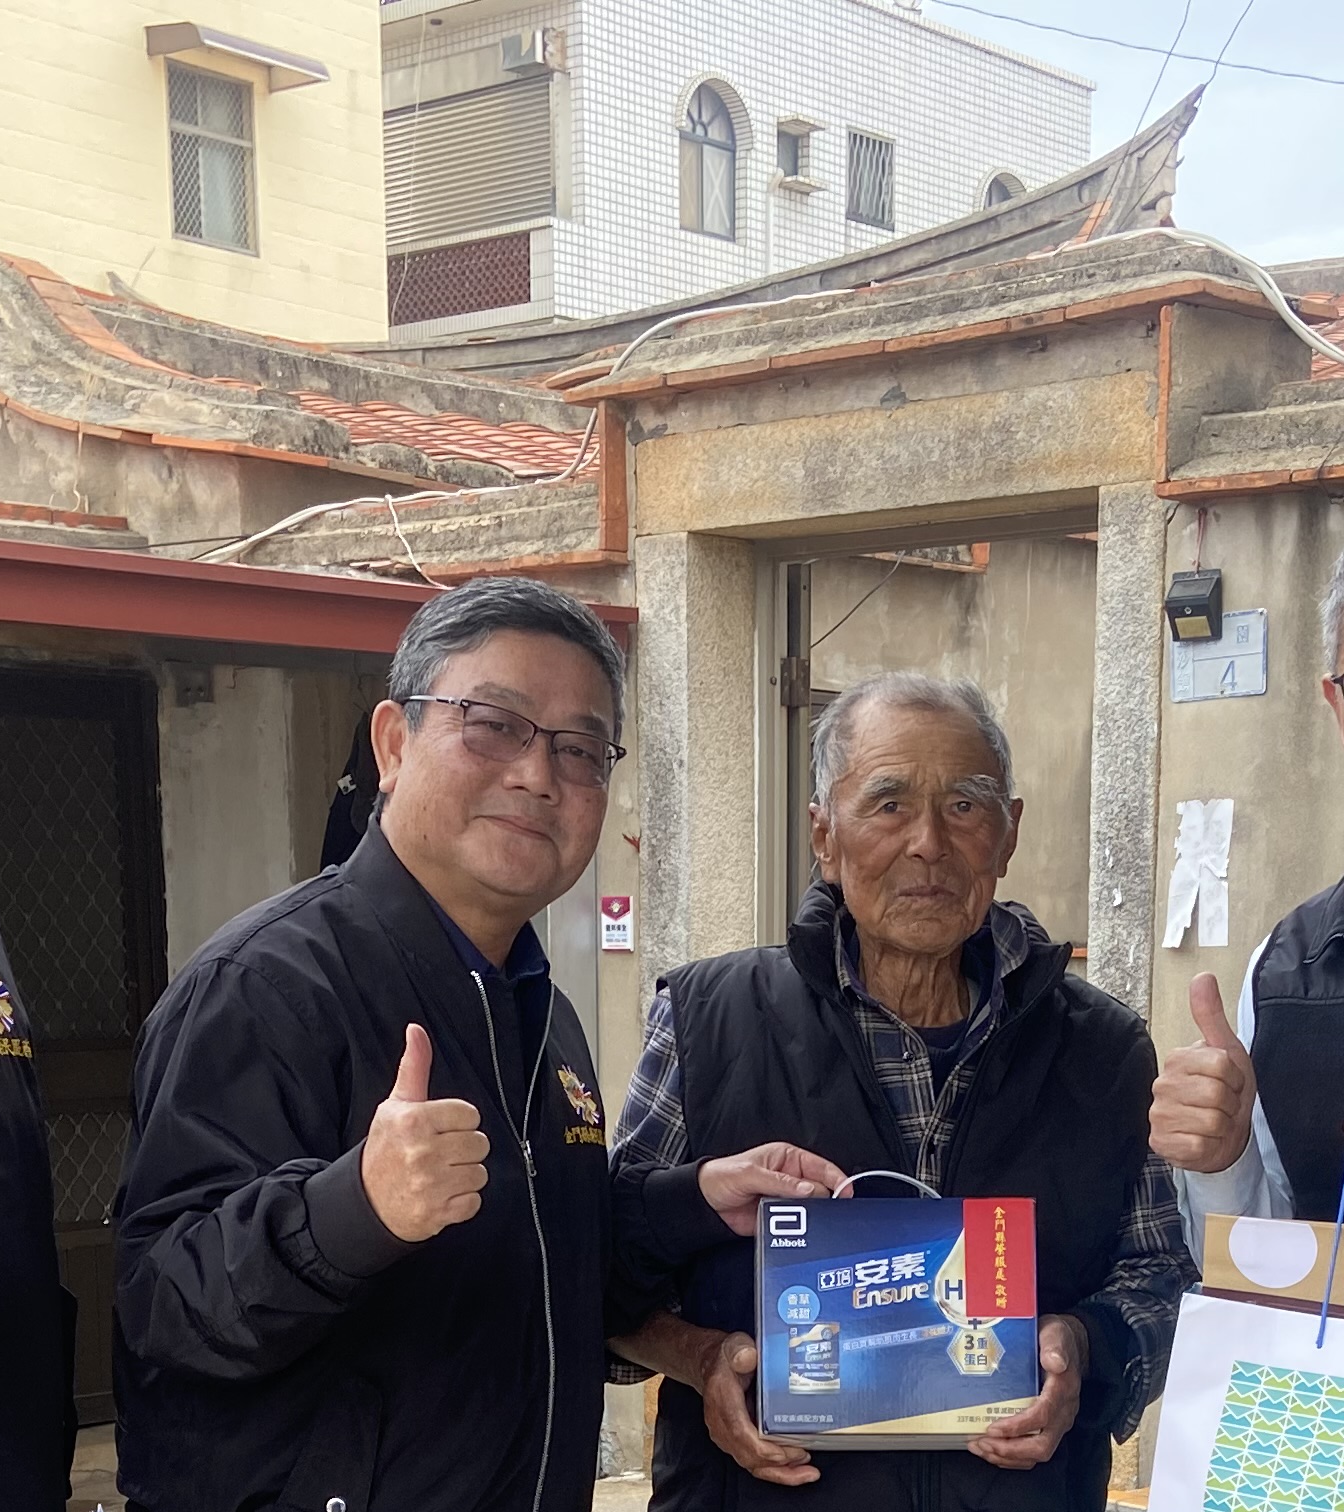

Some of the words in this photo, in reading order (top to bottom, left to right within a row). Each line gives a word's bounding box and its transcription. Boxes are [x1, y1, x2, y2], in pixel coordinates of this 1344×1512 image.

[1220, 659, 1238, 691] 4
[770, 1238, 807, 1247] Abbott
[854, 1251, 926, 1287] 安素
[787, 1293, 810, 1306] 香草
[852, 1281, 930, 1310] Ensure
[964, 1334, 988, 1350] 3重
[964, 1353, 988, 1366] 蛋白
